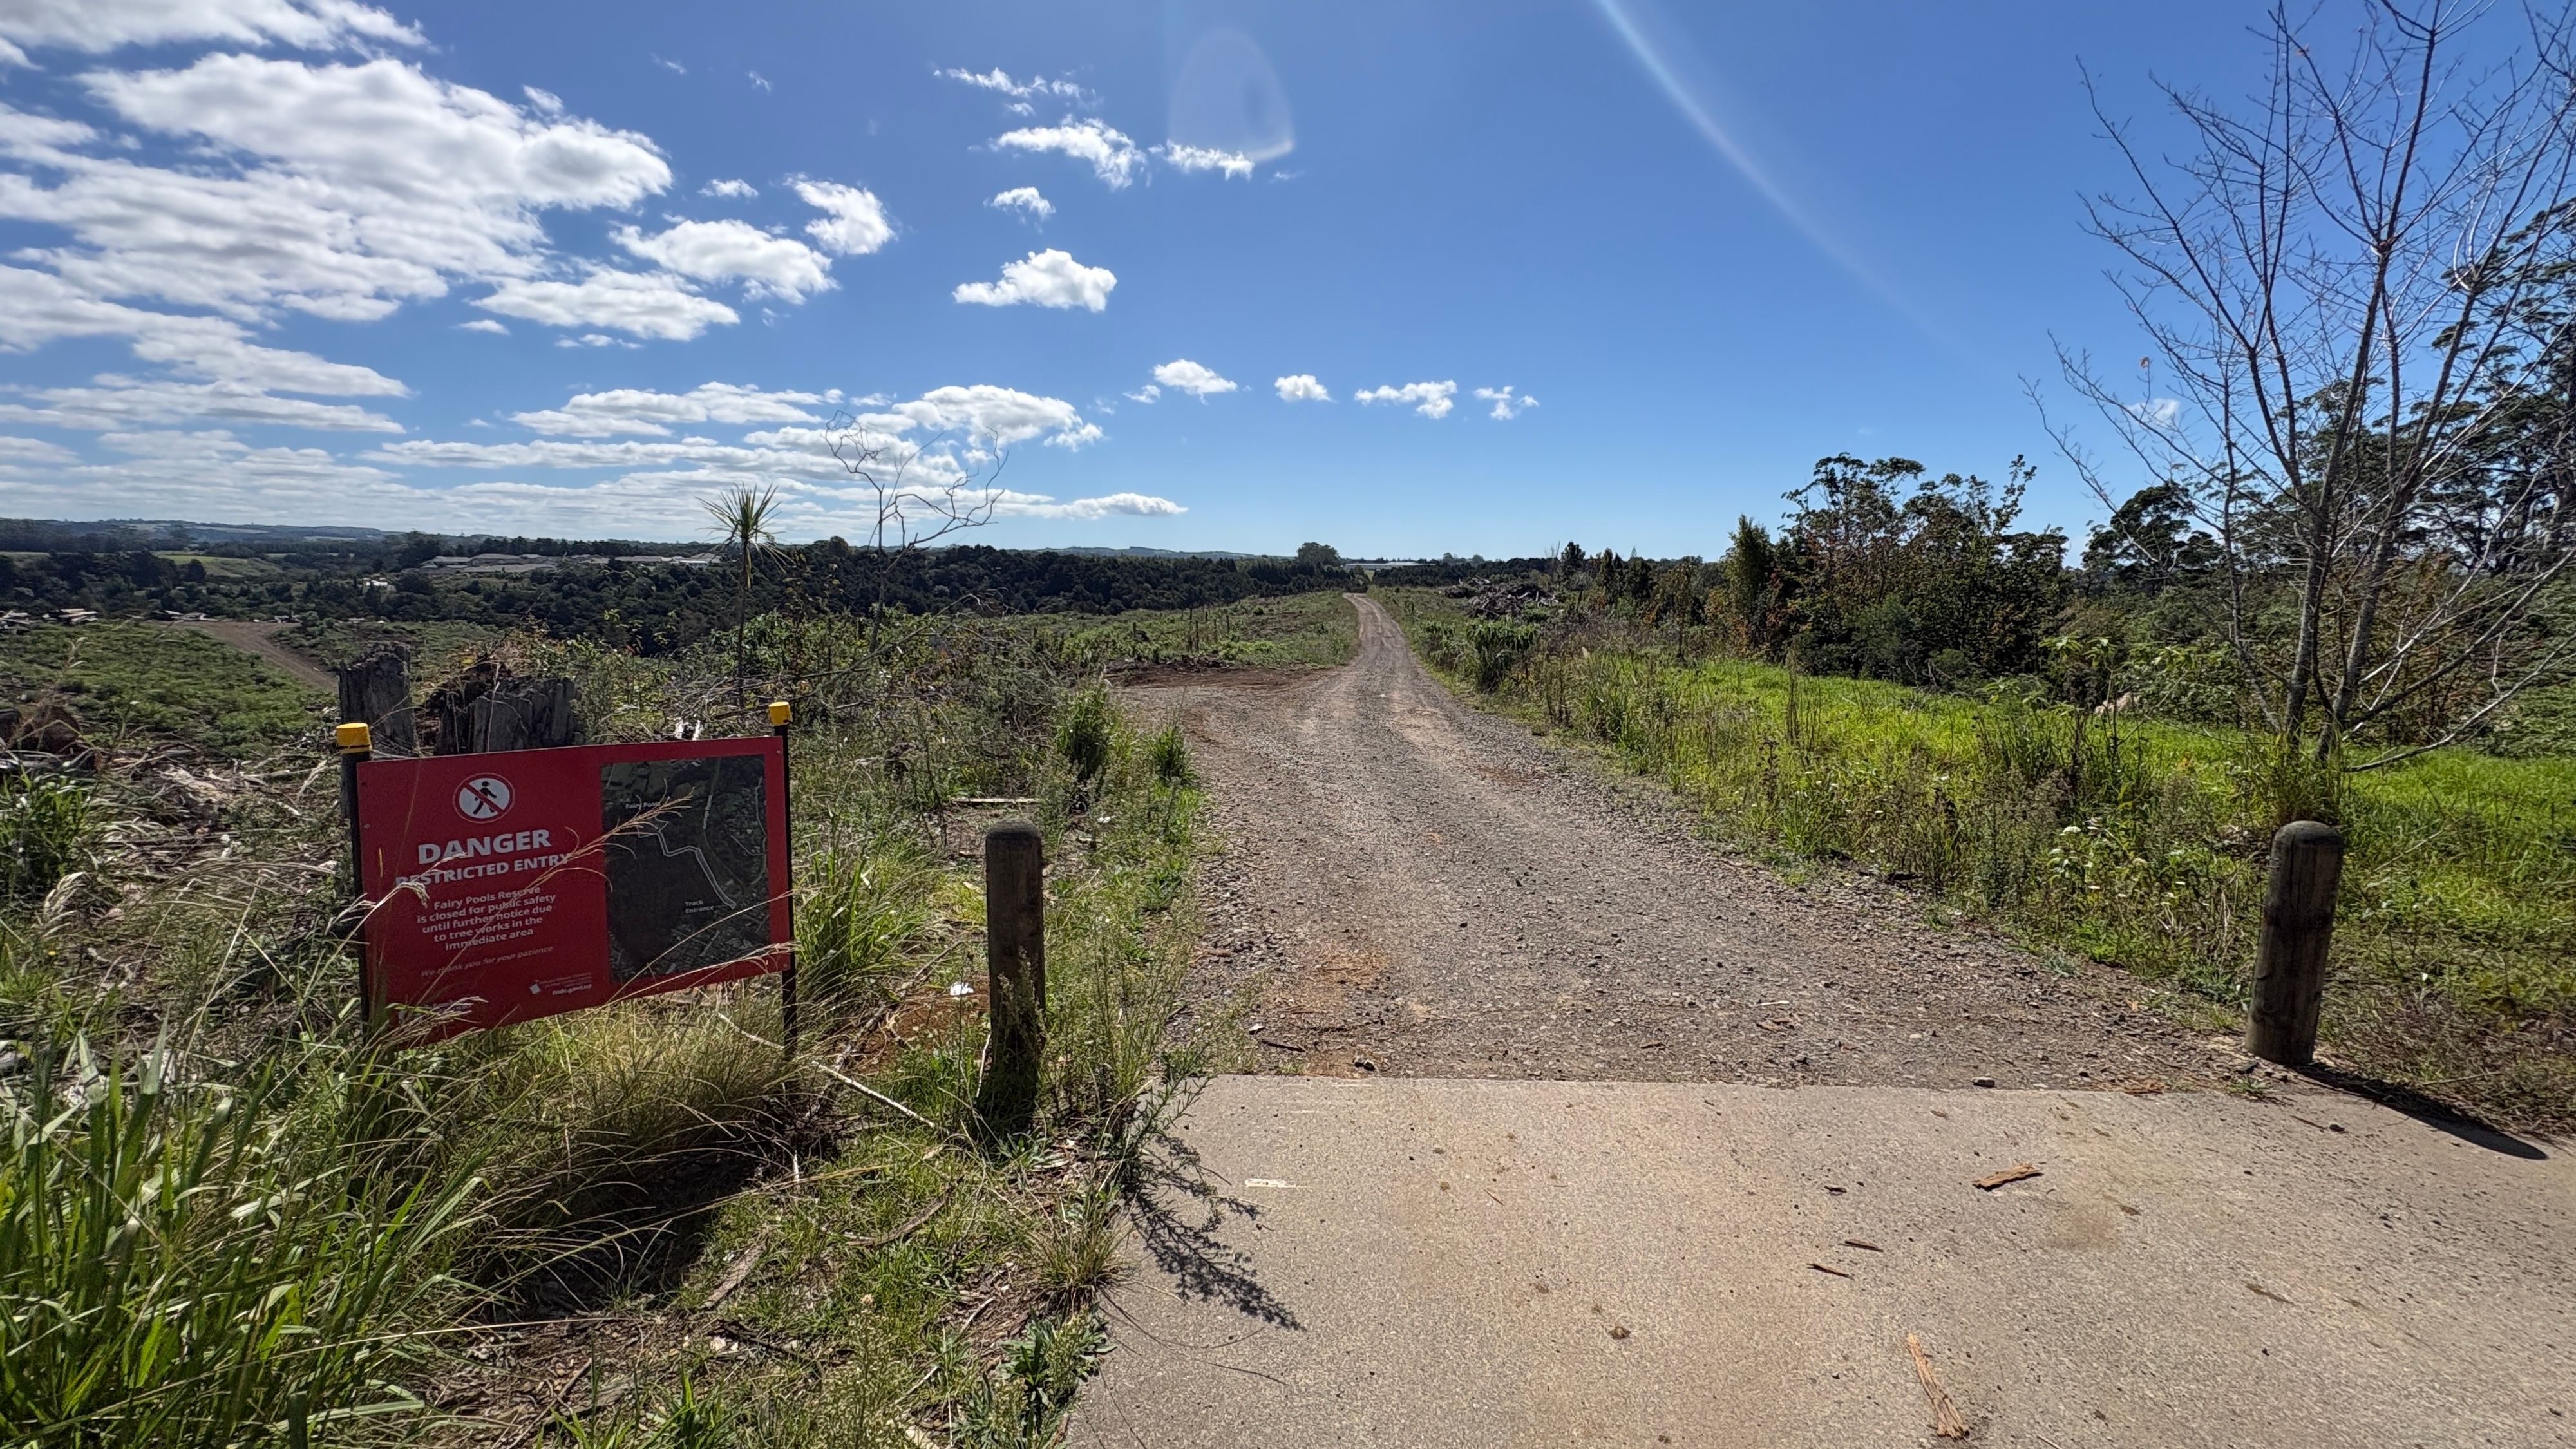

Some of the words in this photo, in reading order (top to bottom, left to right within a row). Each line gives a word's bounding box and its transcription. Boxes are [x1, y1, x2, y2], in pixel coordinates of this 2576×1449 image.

[419, 829, 551, 864] DANGER
[514, 853, 571, 872] ENTRY
[430, 907, 466, 922] closed
[469, 905, 486, 914] for
[488, 900, 521, 913] public
[524, 894, 556, 905] safety
[434, 900, 463, 910] Fairy
[466, 893, 495, 904] Pools
[422, 920, 450, 933] until
[453, 915, 496, 929] further
[497, 908, 530, 920] notice
[532, 904, 553, 914] due
[433, 934, 446, 942] to
[450, 929, 473, 940] tree
[475, 921, 510, 936] works
[512, 917, 522, 927] in
[525, 915, 543, 925] the
[446, 933, 507, 951] immediate
[509, 928, 534, 938] area
[465, 961, 480, 970] you
[483, 956, 495, 965] for
[497, 953, 516, 963] your
[517, 947, 553, 958] patience
